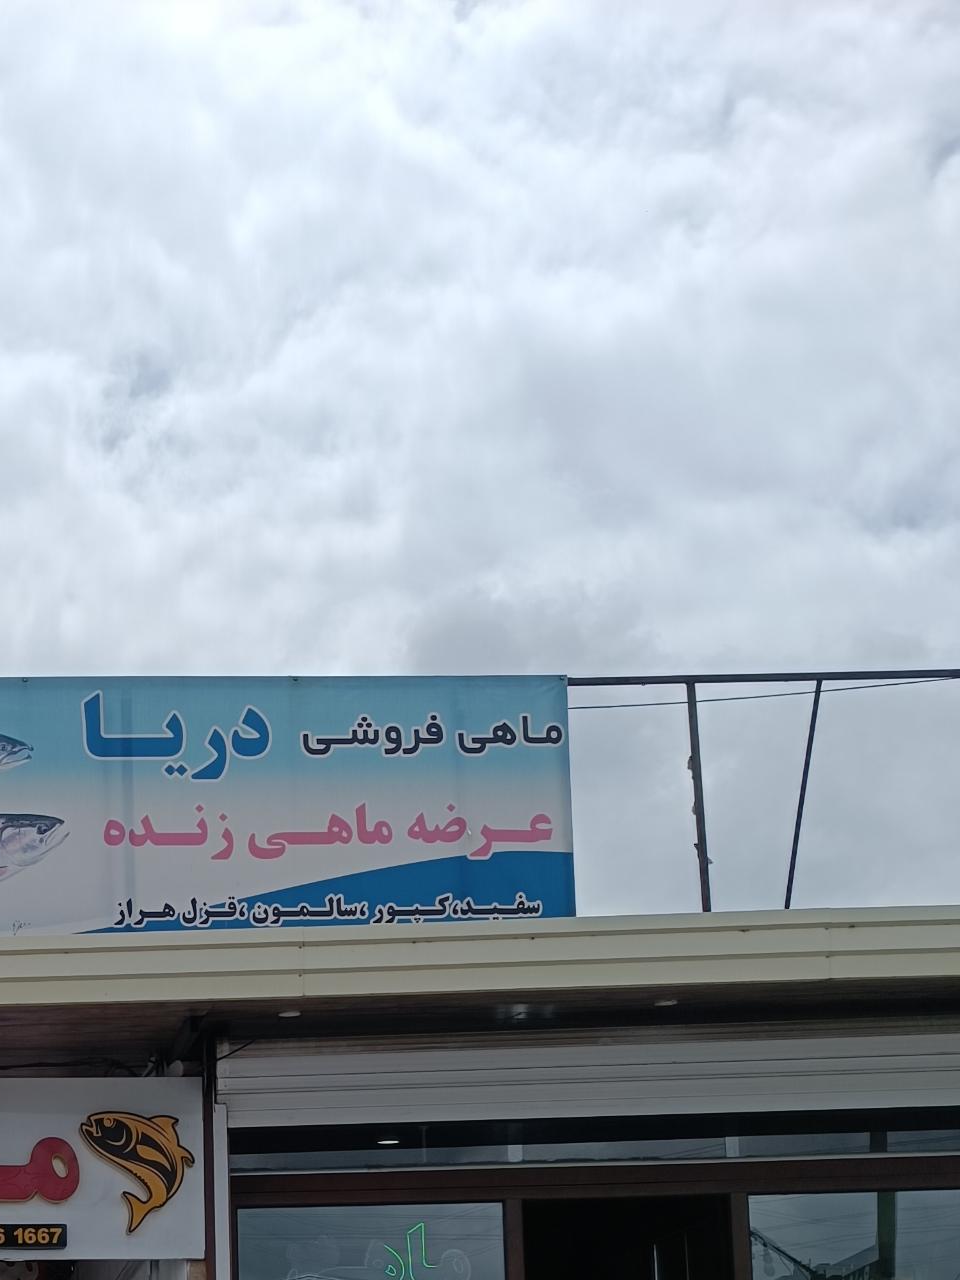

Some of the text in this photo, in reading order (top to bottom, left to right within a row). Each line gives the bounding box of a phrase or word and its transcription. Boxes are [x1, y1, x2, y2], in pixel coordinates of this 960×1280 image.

[82, 691, 564, 781] ماهی فروشی دریا
[102, 803, 555, 860] عرضه ماهی زنده
[114, 897, 177, 927] هراز
[13, 1228, 63, 1246] 1667
